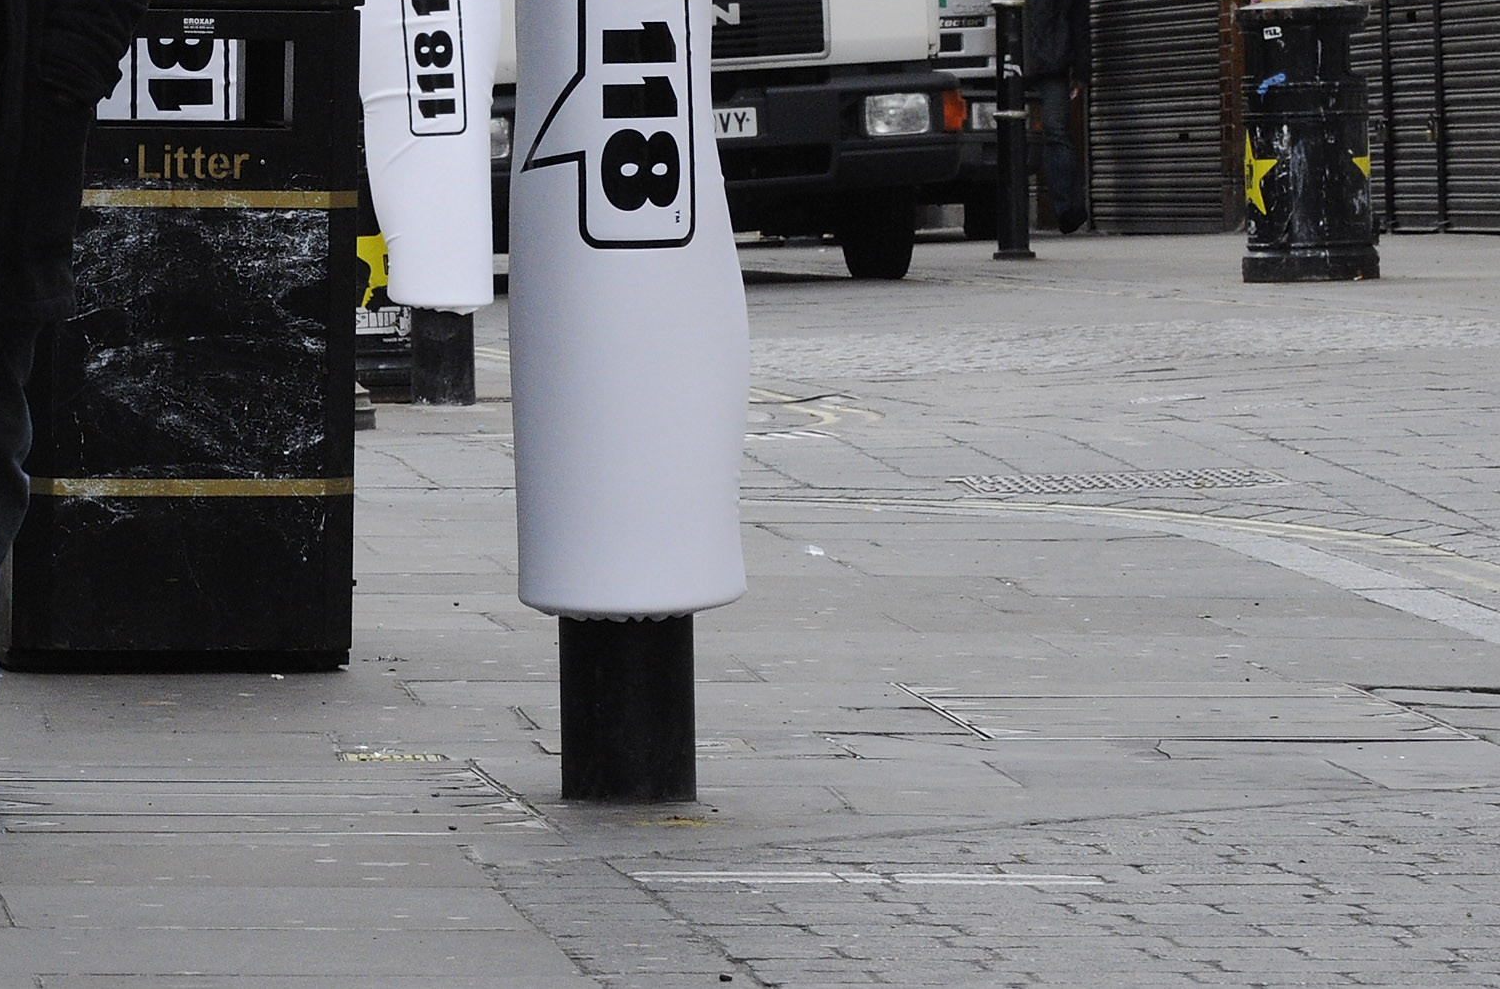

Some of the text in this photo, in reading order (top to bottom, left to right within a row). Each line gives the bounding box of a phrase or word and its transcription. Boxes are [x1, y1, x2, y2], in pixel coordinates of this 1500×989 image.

[414, 30, 456, 119] 118
[601, 21, 680, 212] 118
[715, 112, 746, 133] VY
[138, 144, 250, 180] Litter
